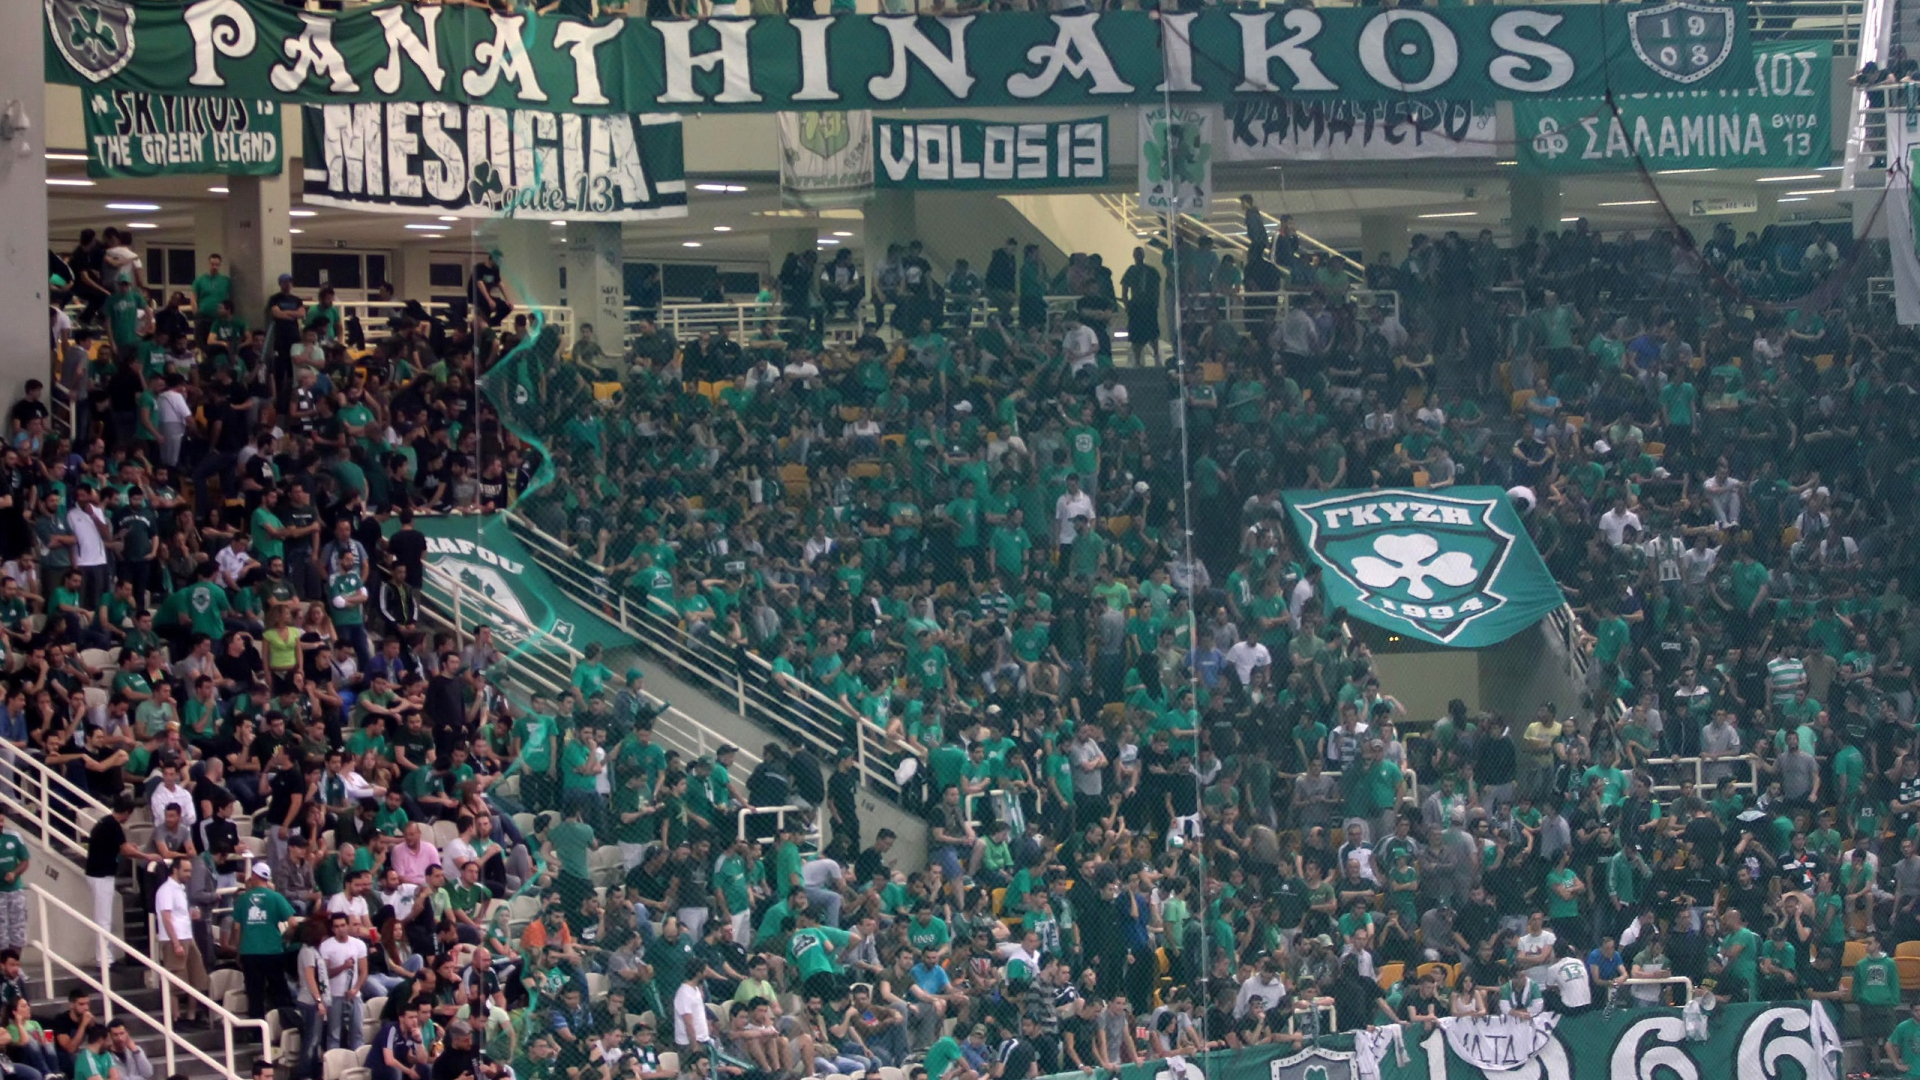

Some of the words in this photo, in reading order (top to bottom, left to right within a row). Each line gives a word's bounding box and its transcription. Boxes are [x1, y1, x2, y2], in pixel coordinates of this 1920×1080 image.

[183, 4, 1575, 104] PANATHINAIKOS
[1579, 113, 1767, 160] ΣΑΛΑΜΙΝΑ
[1771, 113, 1818, 129] ΘΥΡΑ
[1782, 132, 1811, 156] 13
[94, 135, 133, 169] THE
[141, 132, 205, 166] GREEN
[212, 131, 277, 164] ISLAND
[323, 101, 650, 203] MESOGIA
[880, 123, 1048, 182] VOLOS
[1057, 122, 1103, 179] 13
[502, 183, 565, 218] gate
[571, 171, 615, 213] 13
[1322, 501, 1474, 530] ΓΚΥΖΗ
[1379, 597, 1485, 620] 1994
[1419, 1007, 1829, 1080] 166
